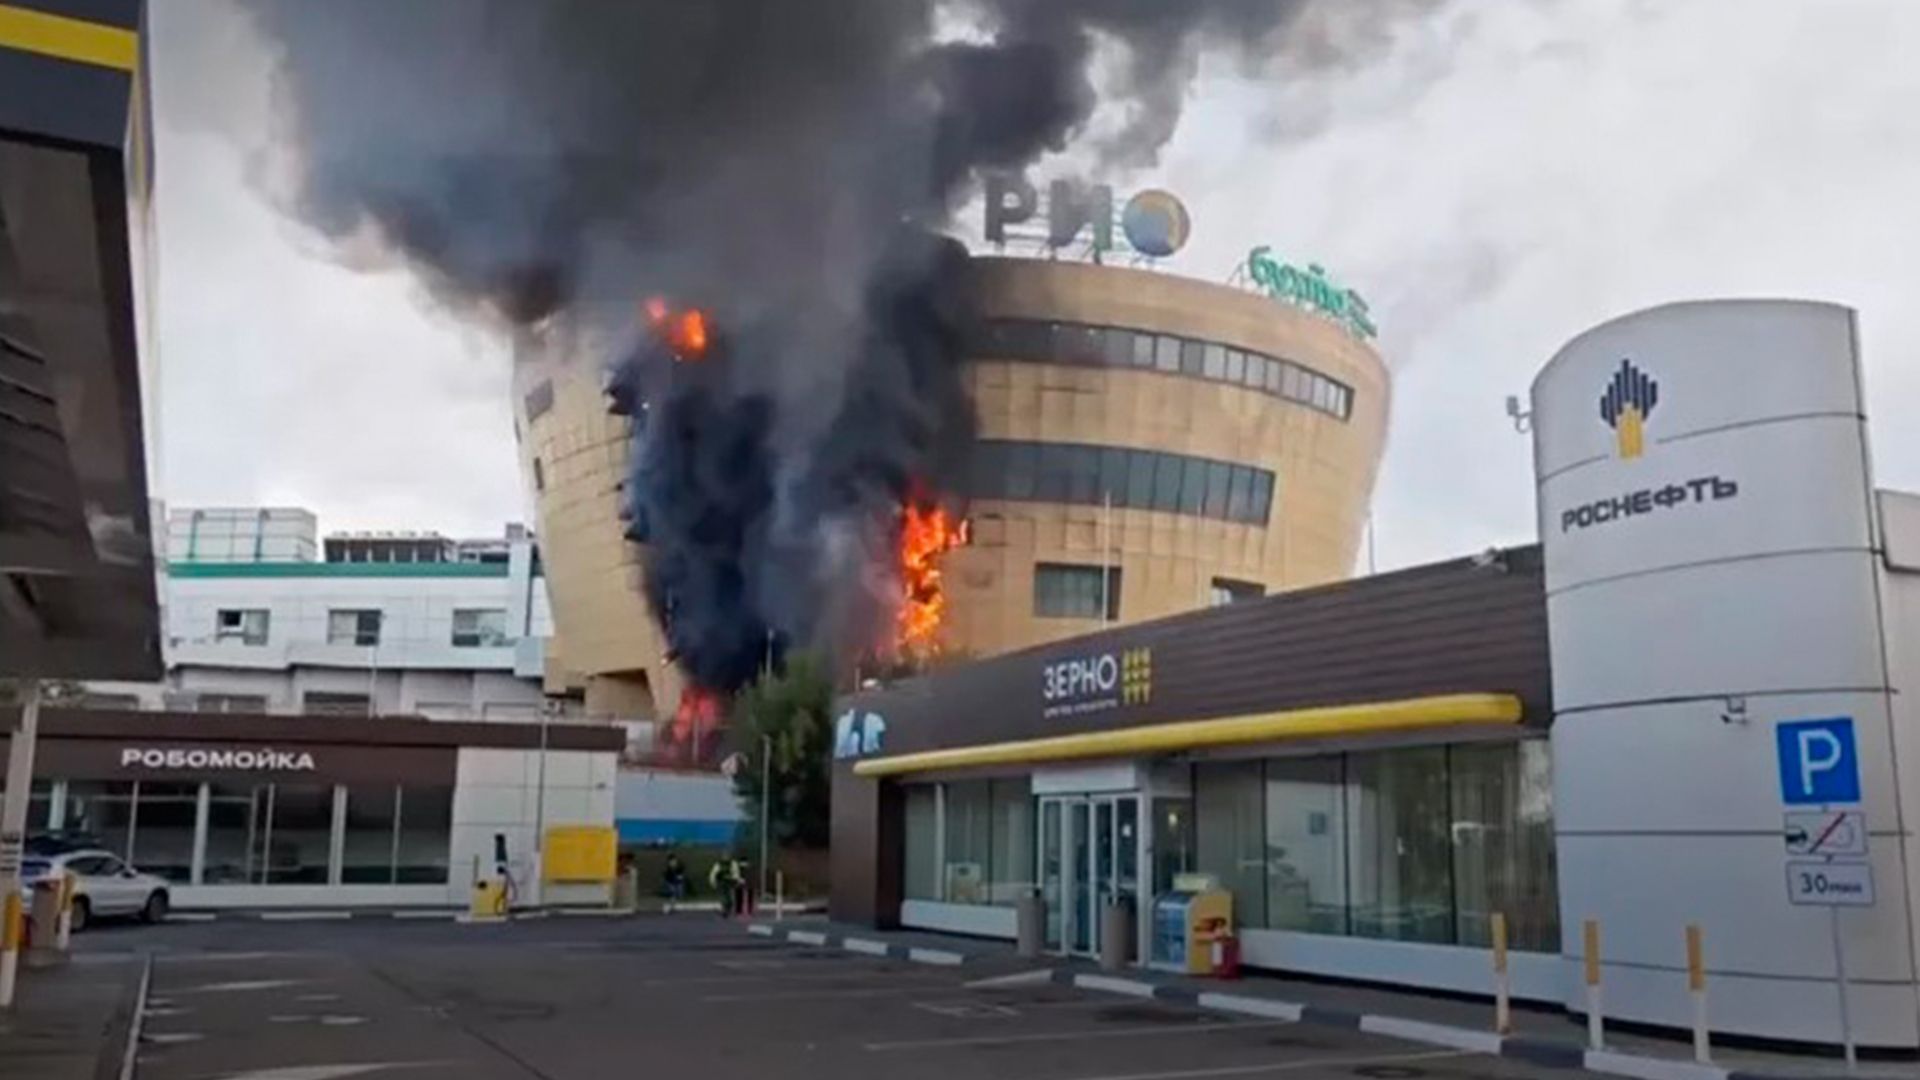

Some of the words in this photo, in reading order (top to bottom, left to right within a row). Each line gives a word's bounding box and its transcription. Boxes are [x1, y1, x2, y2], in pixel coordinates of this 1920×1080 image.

[1561, 476, 1739, 533] РОСНЕФТЬ
[1043, 654, 1118, 699] ЗЕРНО
[121, 748, 315, 769] РОБОМОЙКА
[1798, 728, 1842, 795] P
